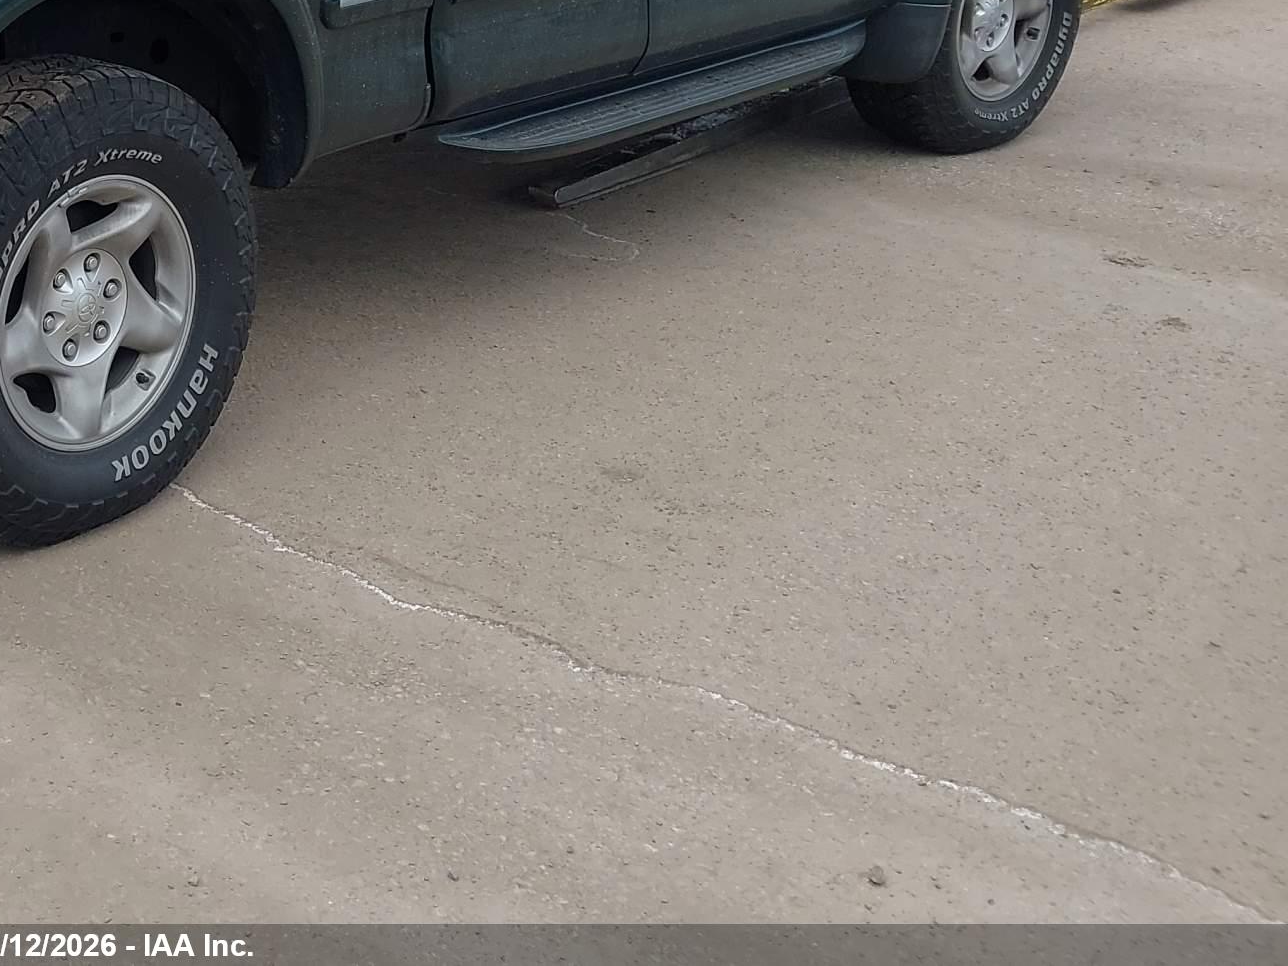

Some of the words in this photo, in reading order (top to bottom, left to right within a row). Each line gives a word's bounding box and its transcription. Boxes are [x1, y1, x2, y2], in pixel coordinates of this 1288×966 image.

[1010, 99, 1030, 119] AT2
[48, 159, 88, 198] AT2
[93, 147, 165, 167] Xtreme
